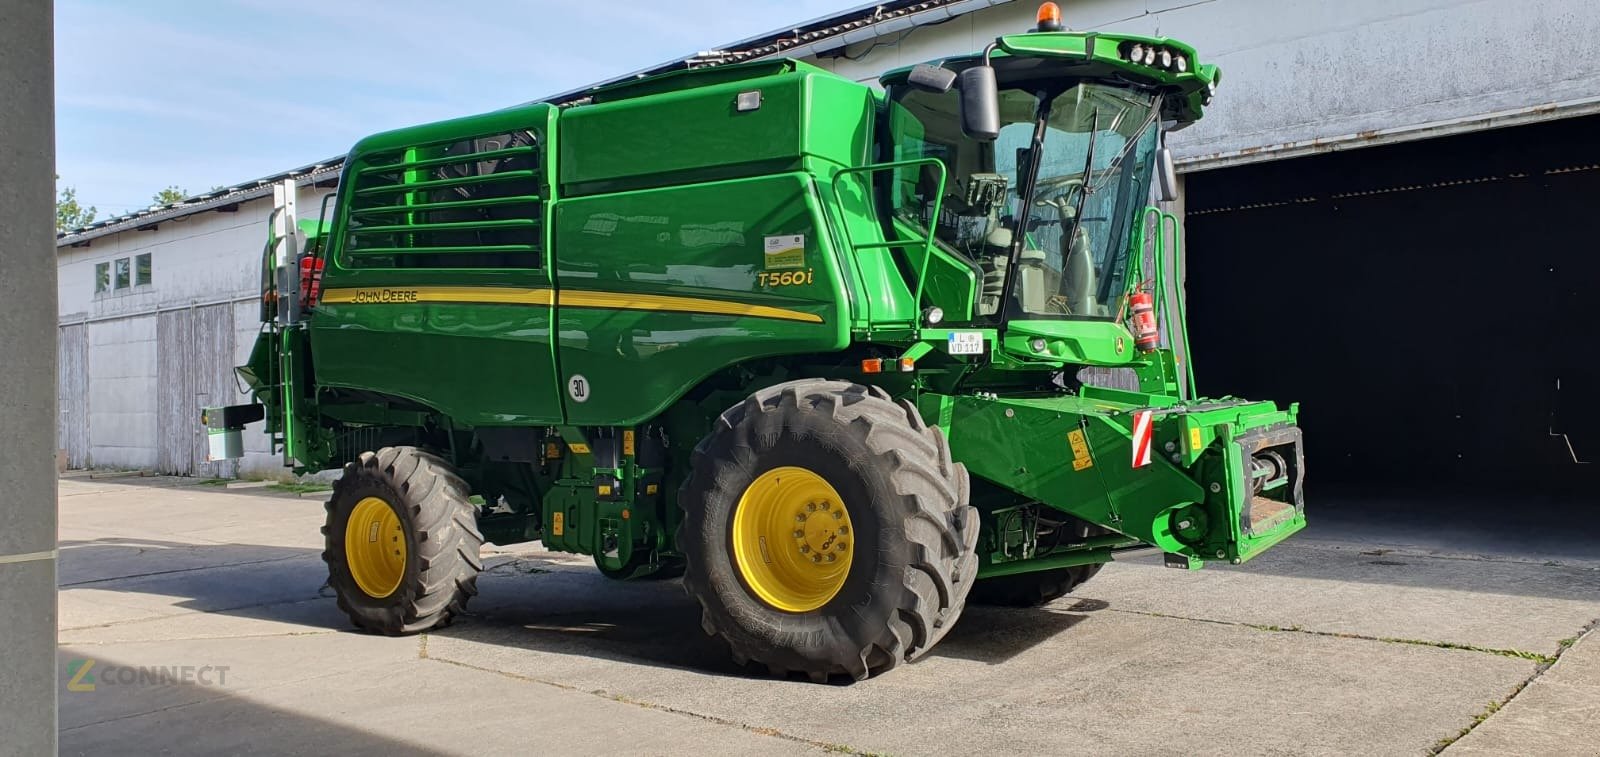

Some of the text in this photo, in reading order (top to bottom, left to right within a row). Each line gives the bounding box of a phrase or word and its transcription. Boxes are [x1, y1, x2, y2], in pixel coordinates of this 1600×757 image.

[758, 267, 813, 287] T560i
[351, 288, 418, 302] JOHN DEERE
[573, 379, 585, 397] 30
